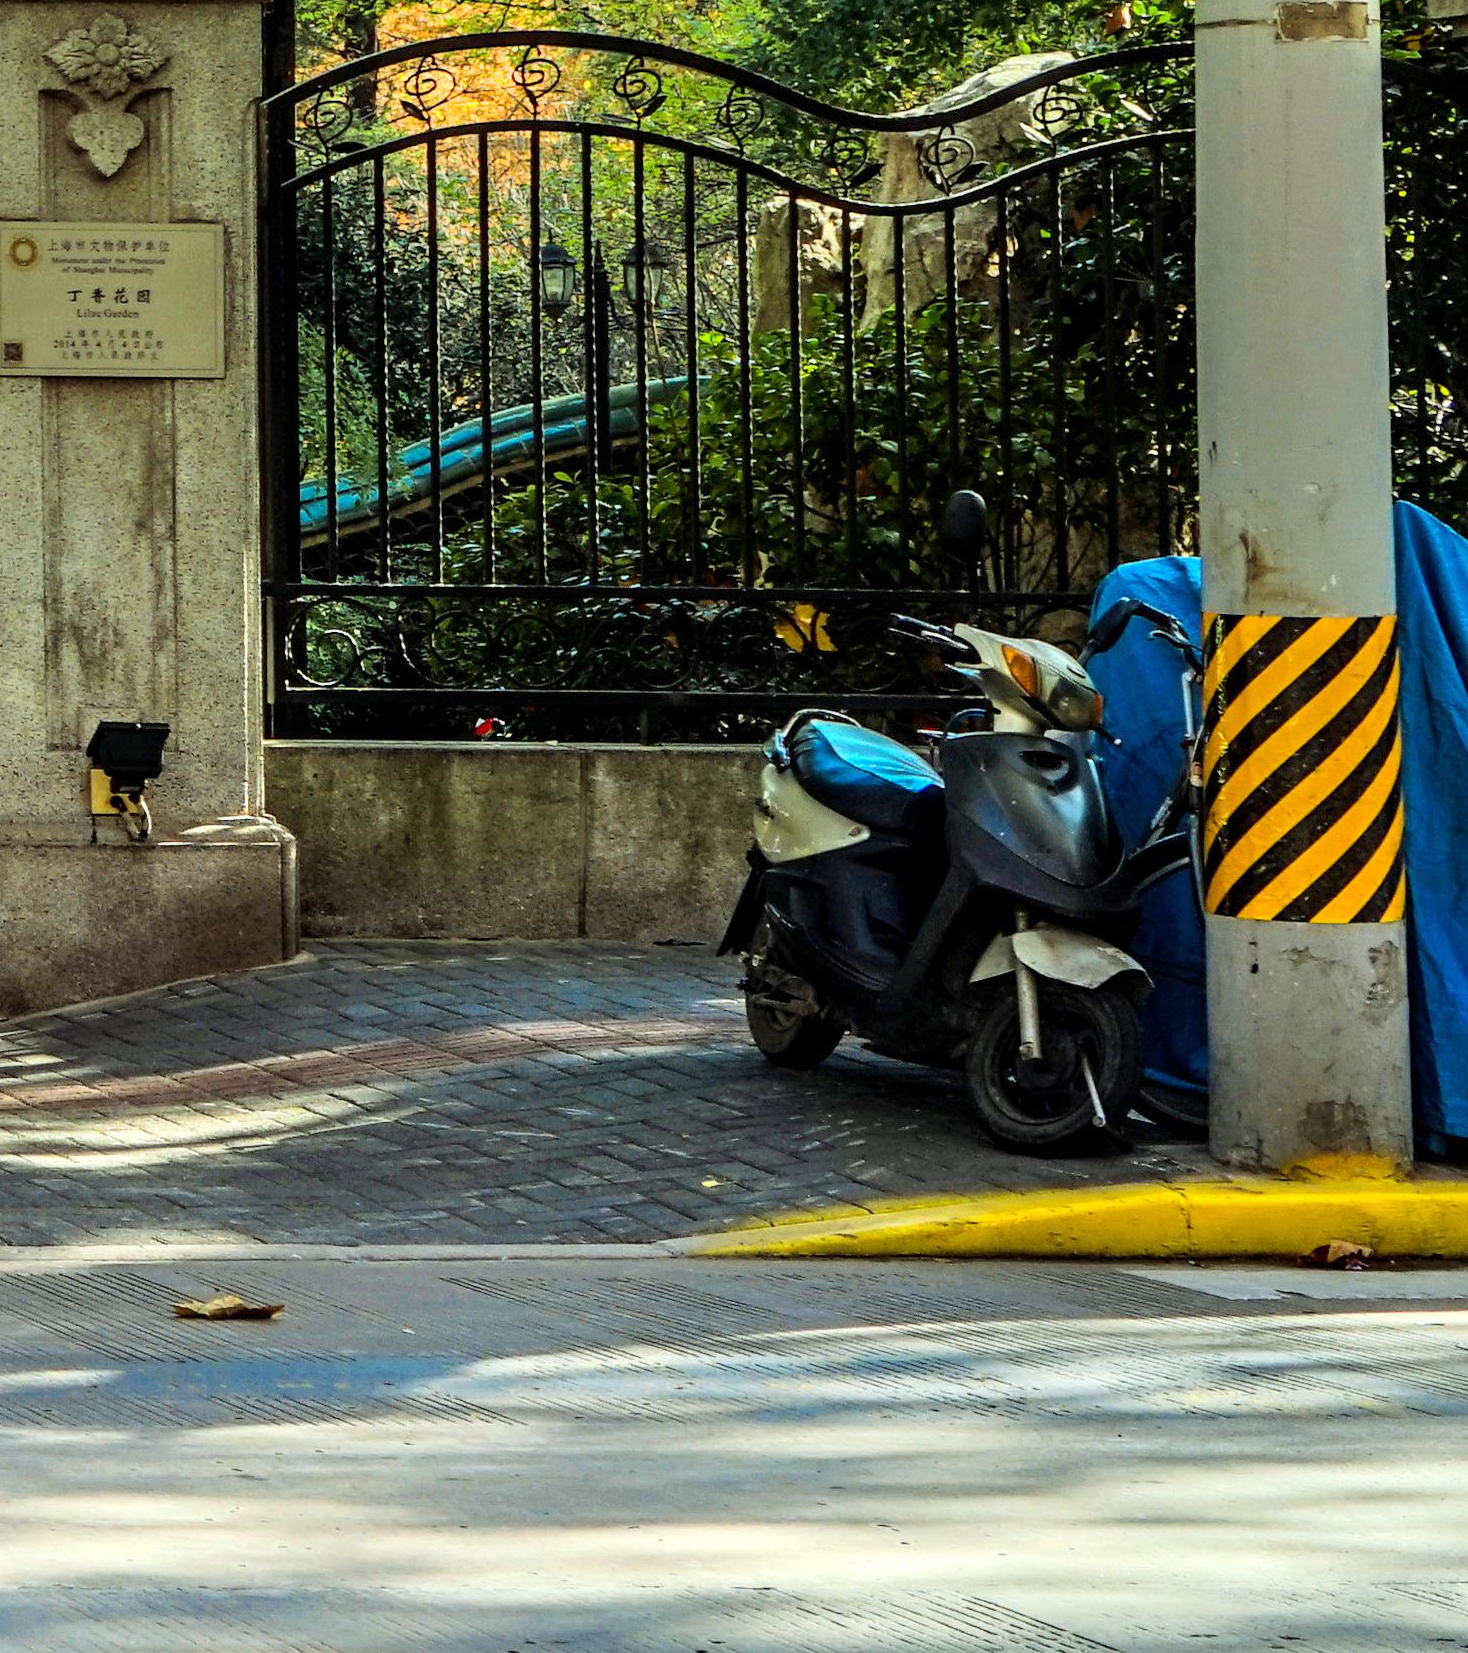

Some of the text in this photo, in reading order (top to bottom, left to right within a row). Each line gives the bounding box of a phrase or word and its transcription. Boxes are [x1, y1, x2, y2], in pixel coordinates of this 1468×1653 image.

[48, 239, 170, 253] 上海市文物保护单位
[66, 287, 150, 304] 丁香花园
[76, 309, 139, 318] Lilac Garden
